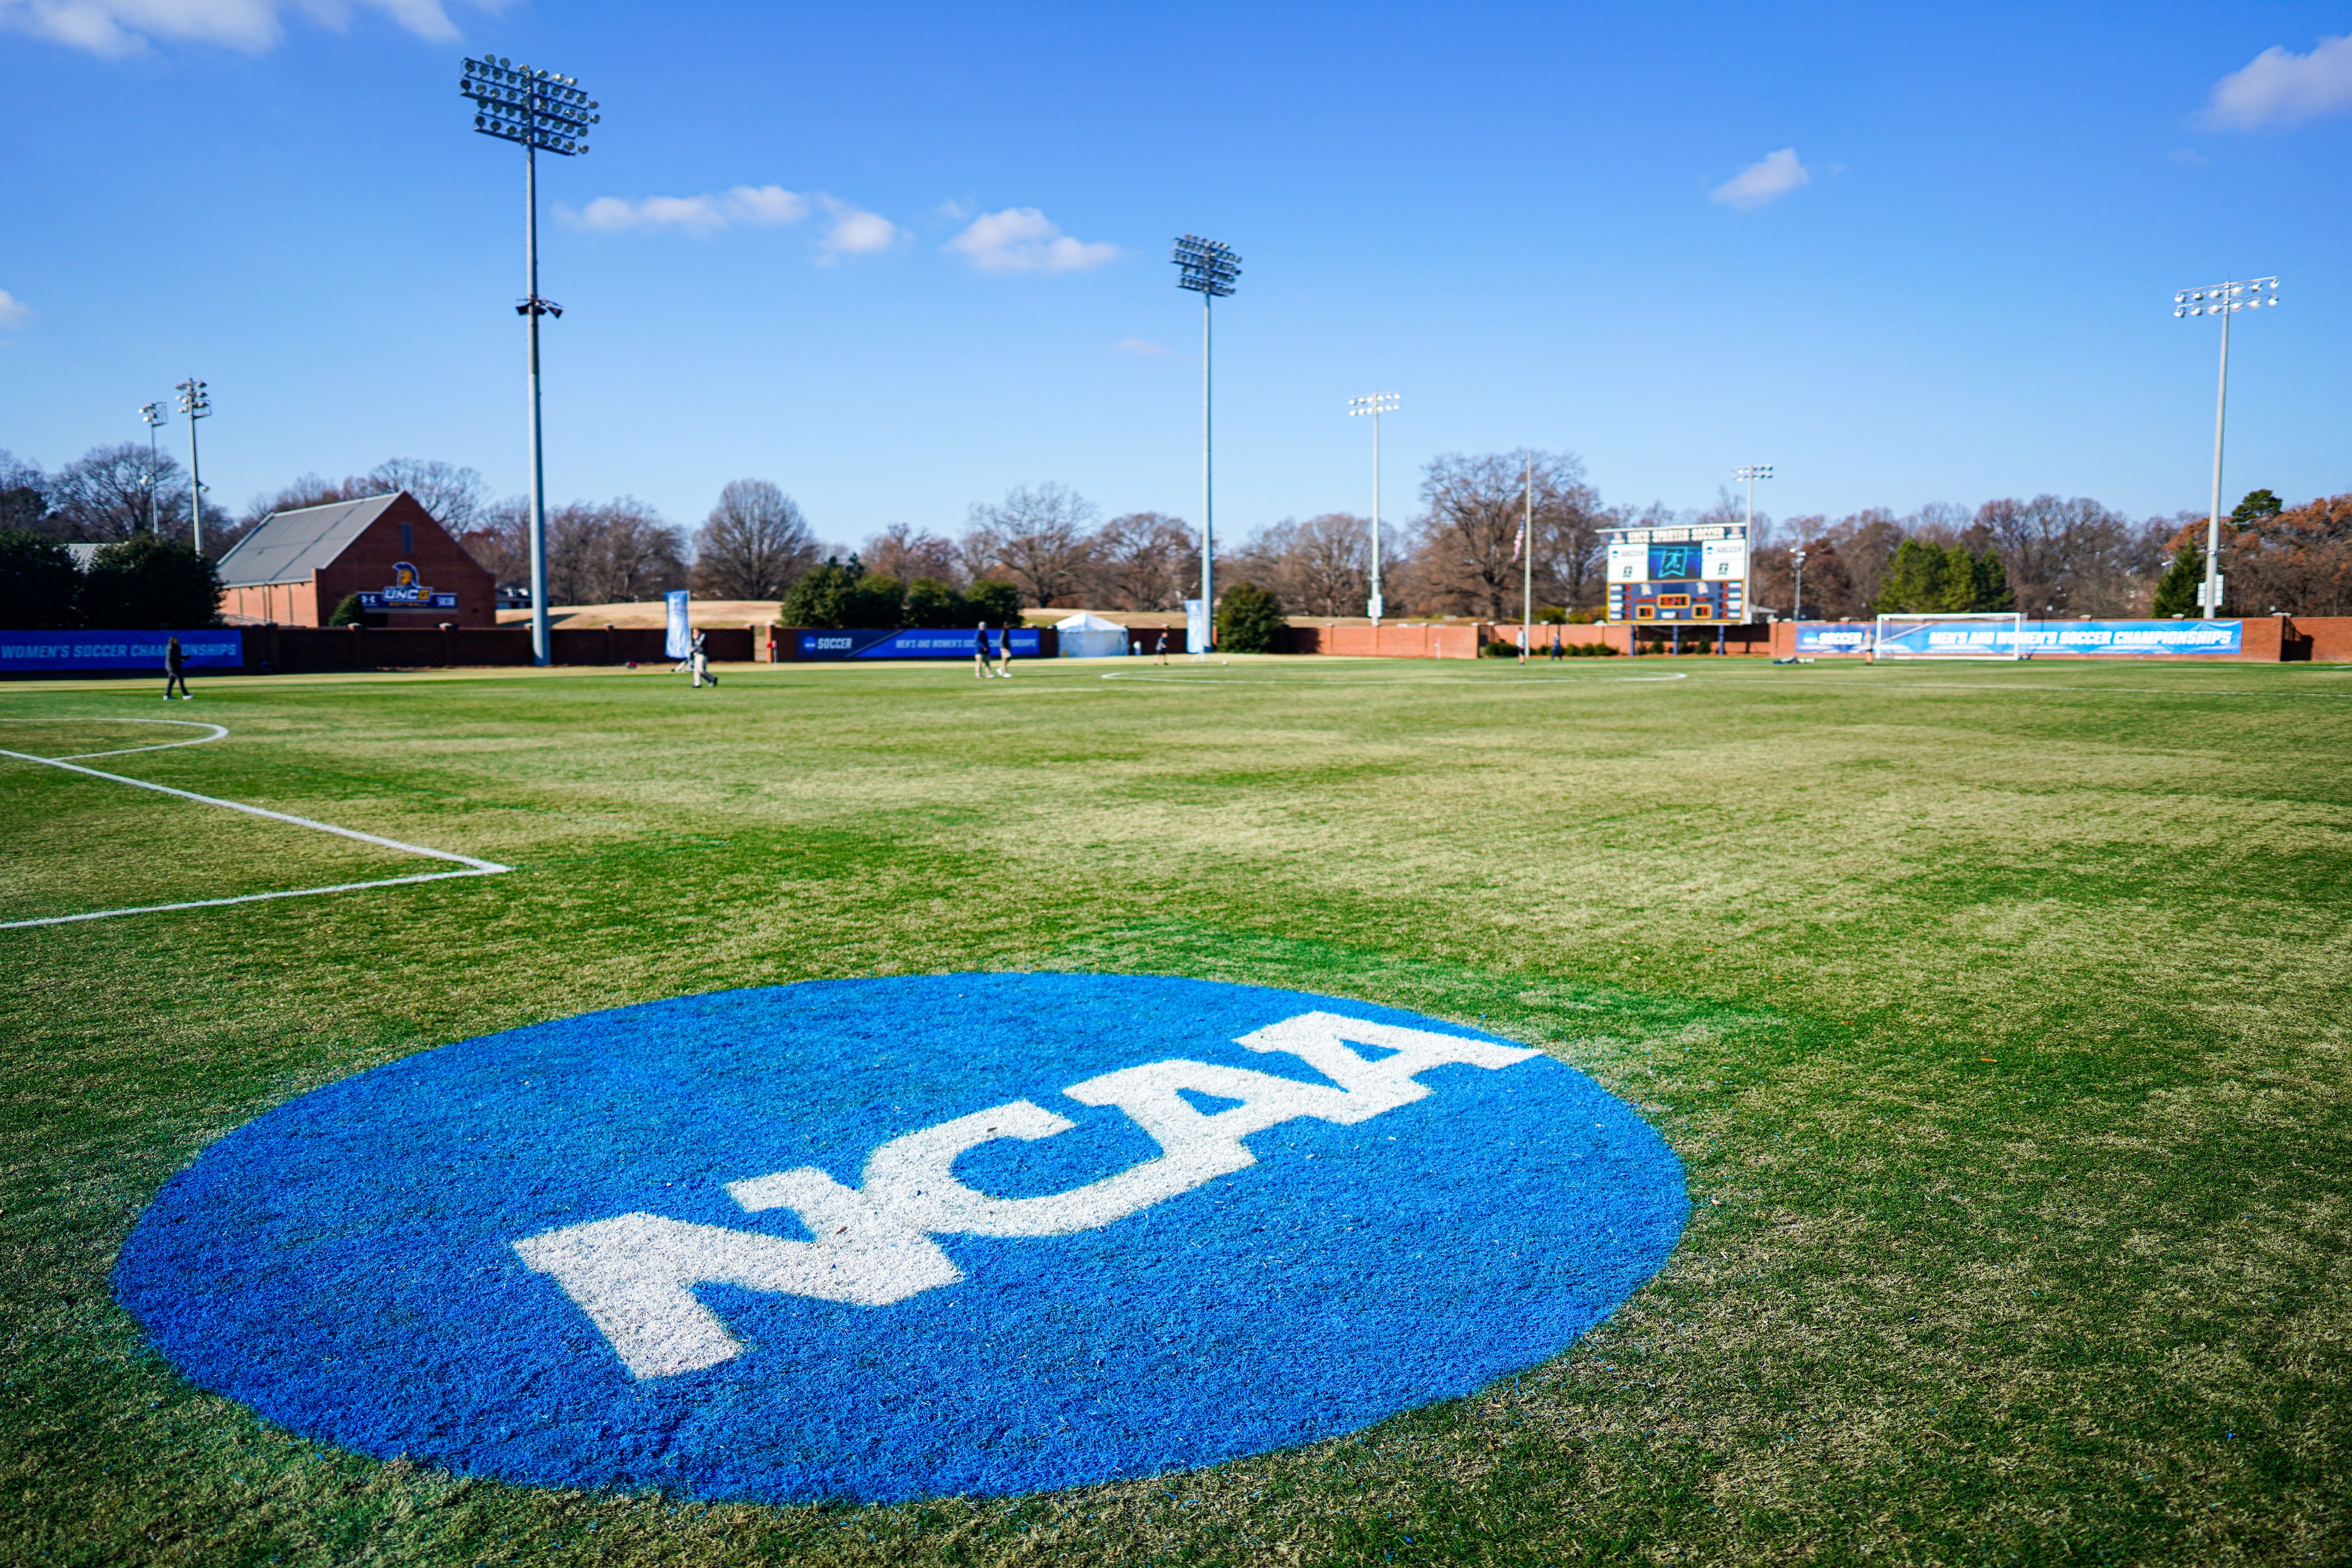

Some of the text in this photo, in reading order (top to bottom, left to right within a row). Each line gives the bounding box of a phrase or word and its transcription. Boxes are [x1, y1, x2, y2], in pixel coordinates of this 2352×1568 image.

[384, 589, 429, 600] UNCG
[818, 638, 852, 649] SOCCER
[1818, 632, 1863, 645] SOCCER
[1928, 631, 2233, 645] MEN'S AND WOMEN'S SOCCER CHAMPIONSHIPS
[1, 644, 236, 657] WOMEN'S SOCCER CHAMONSHIPS
[512, 1010, 1545, 1381] NCAA
